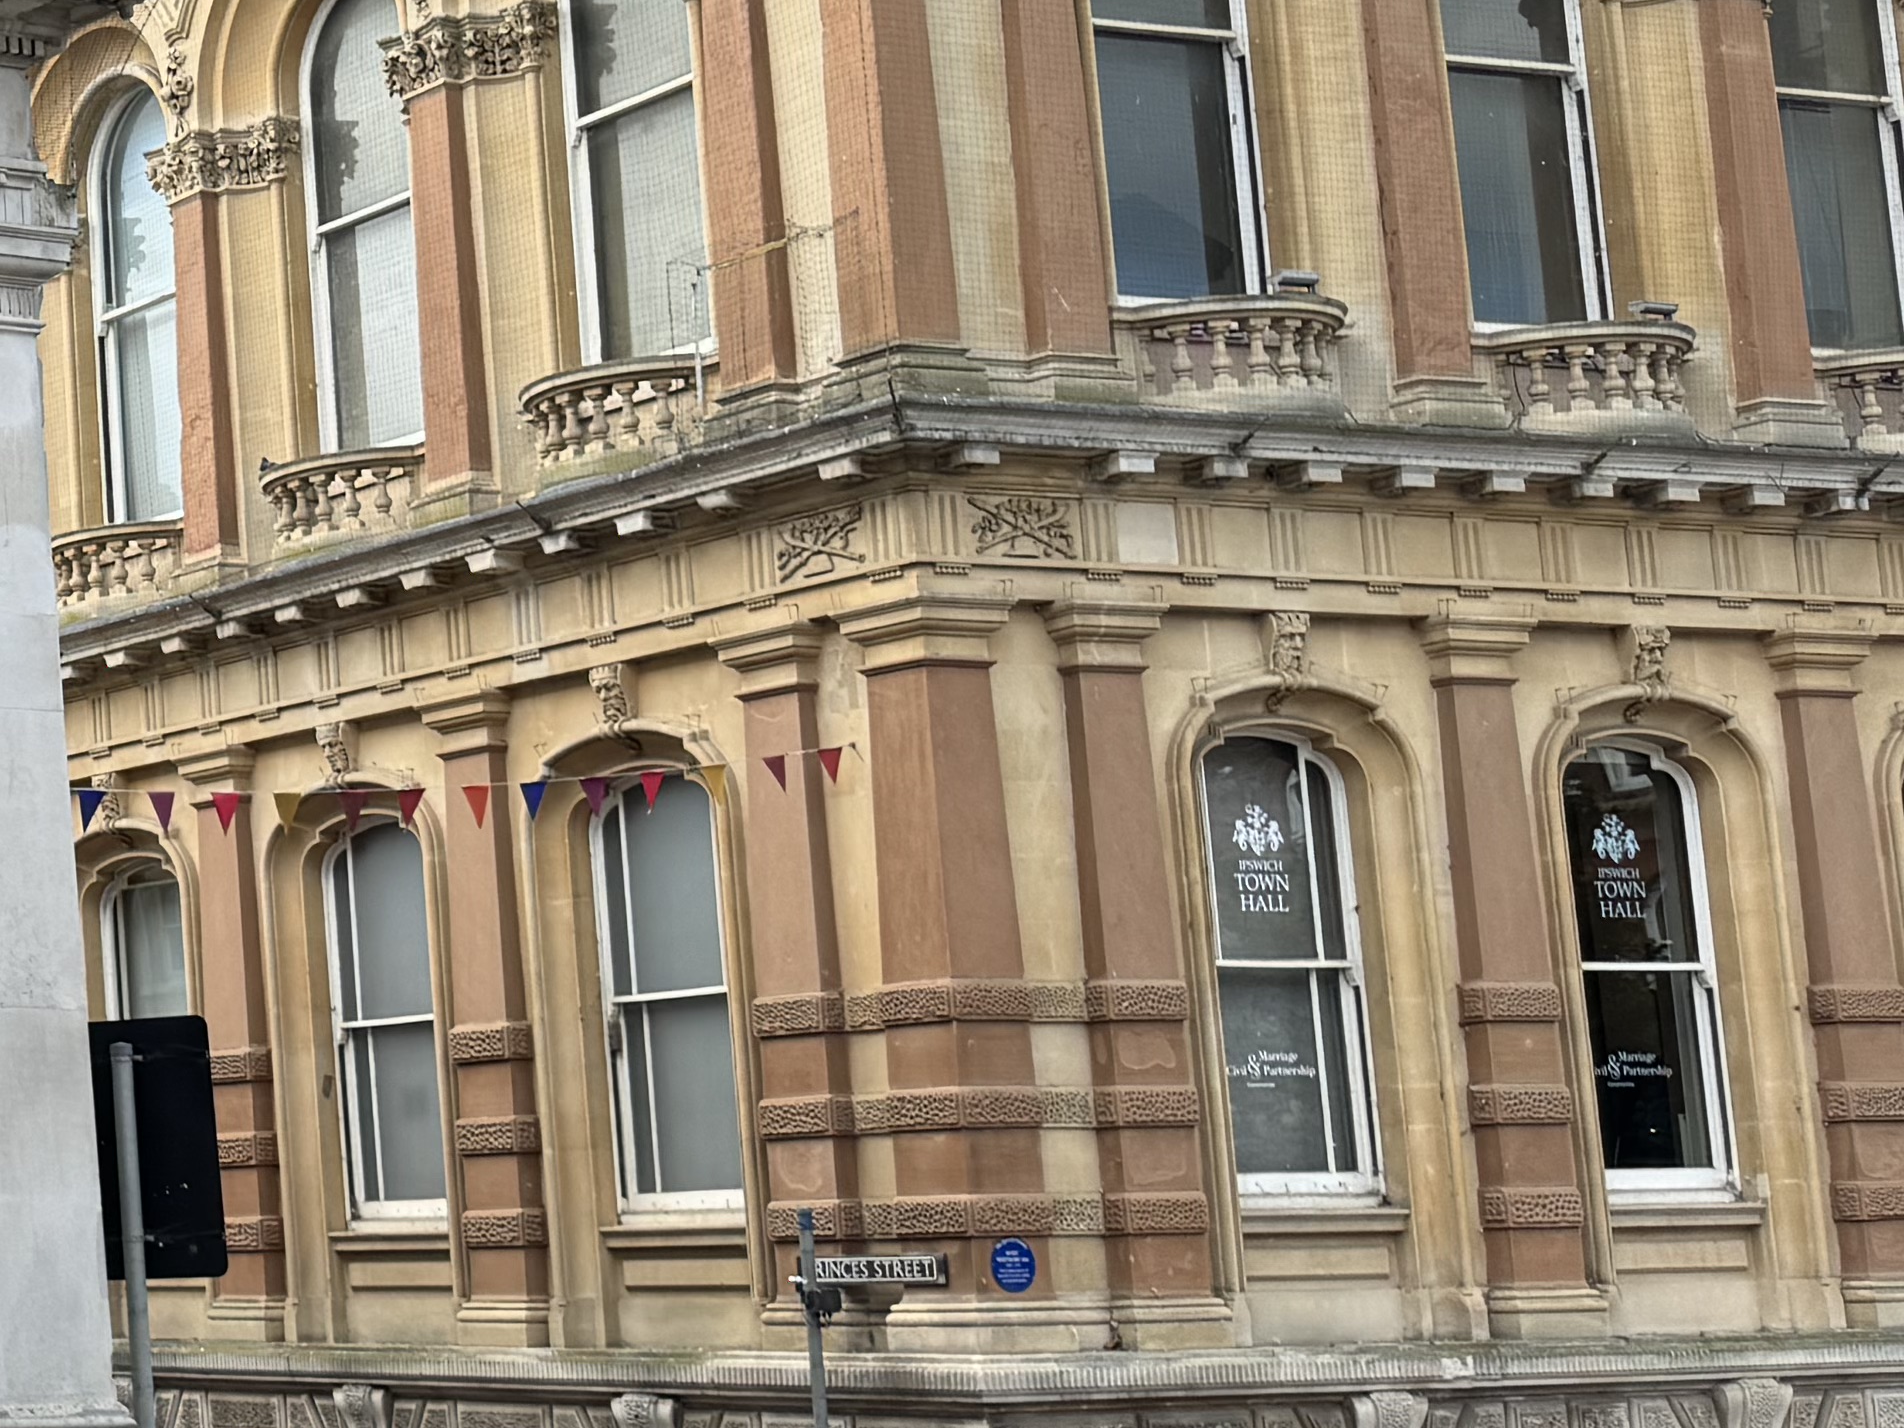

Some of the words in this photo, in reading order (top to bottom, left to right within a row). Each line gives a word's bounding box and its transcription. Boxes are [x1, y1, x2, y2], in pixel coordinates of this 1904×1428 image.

[1238, 859, 1283, 872] IPSWICH
[1597, 867, 1640, 879] IPSWICH
[1233, 873, 1290, 892] TOWN
[1593, 880, 1647, 898] TOWN
[1240, 894, 1290, 912] HALL
[1600, 901, 1647, 918] HALL
[1258, 1050, 1298, 1063] Marriage
[1247, 1054, 1261, 1080] &
[1263, 1064, 1316, 1078] Partnership
[1607, 1054, 1621, 1080] &
[815, 1259, 869, 1278] RINCES
[874, 1259, 932, 1278] STREET
